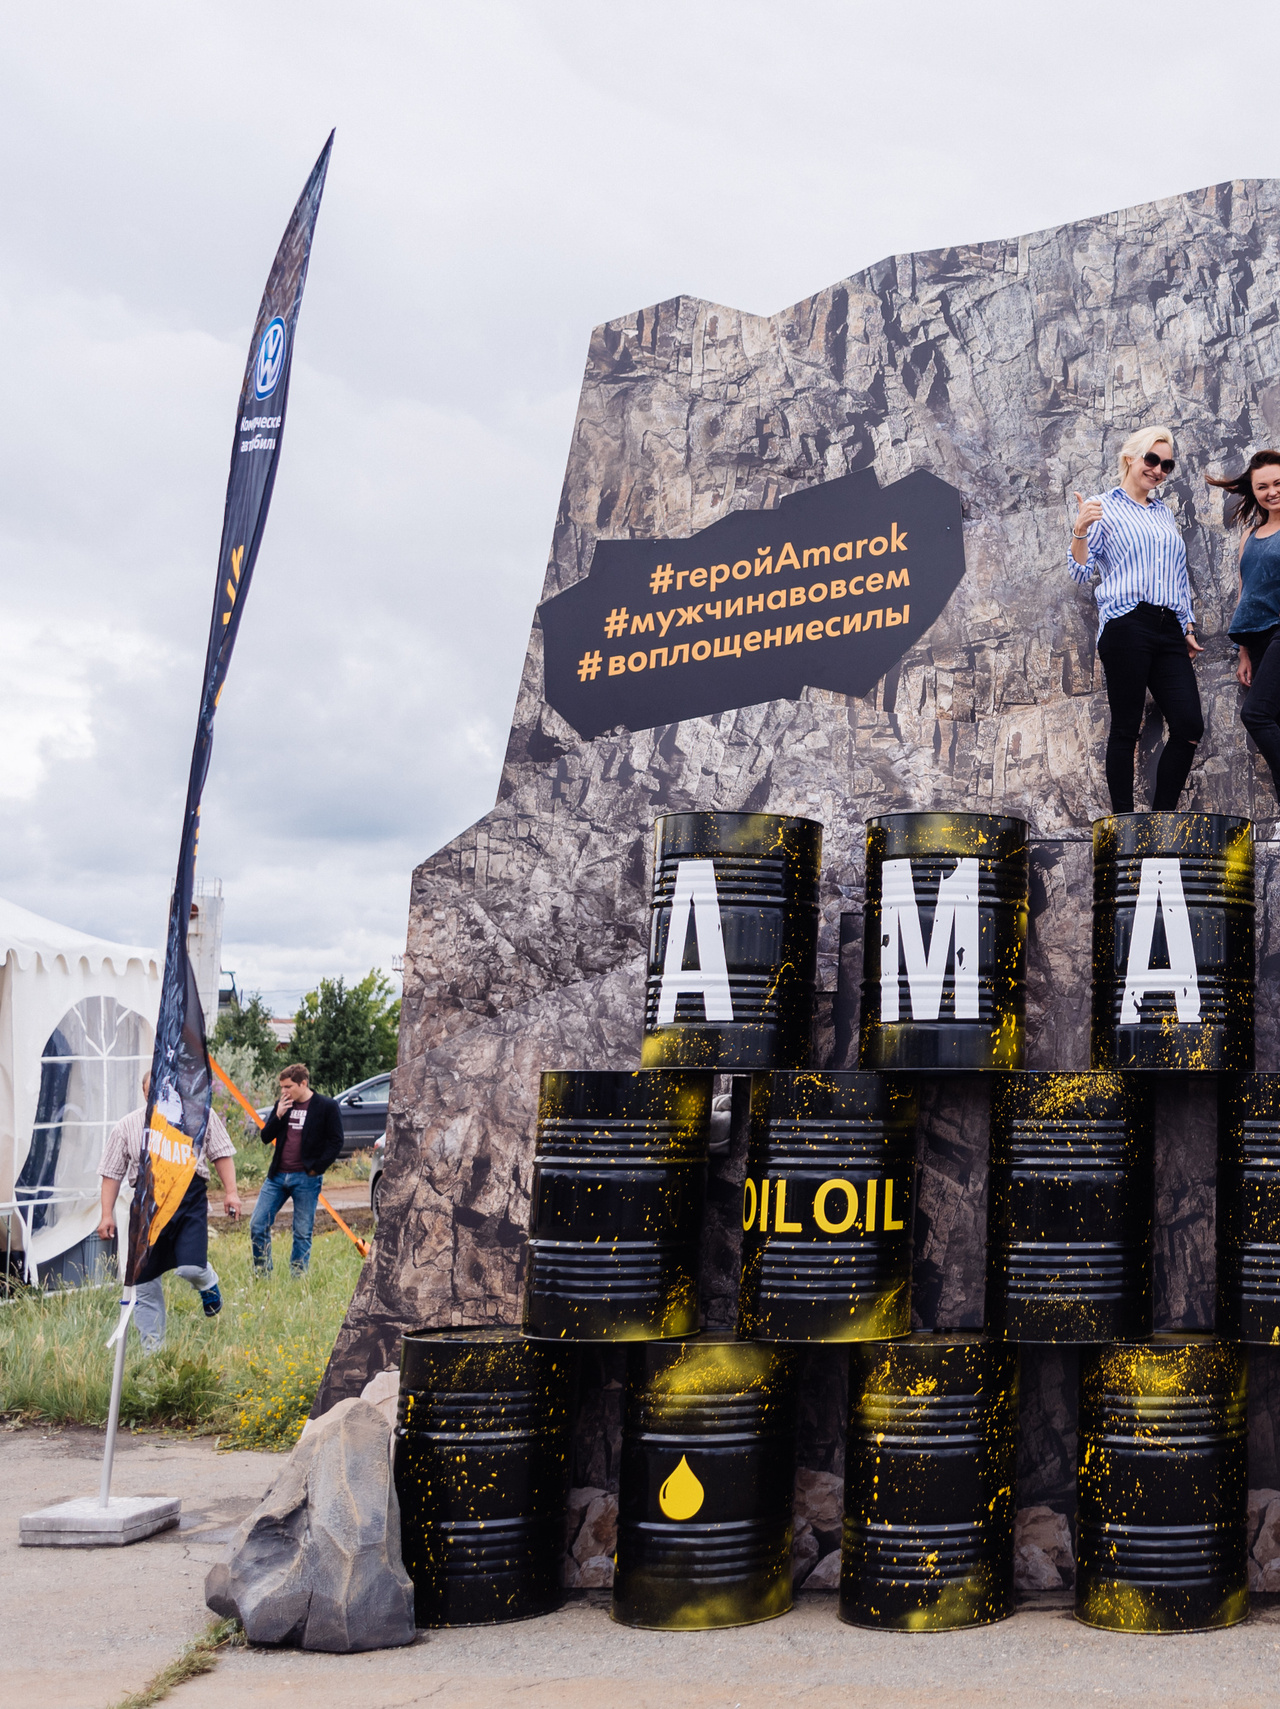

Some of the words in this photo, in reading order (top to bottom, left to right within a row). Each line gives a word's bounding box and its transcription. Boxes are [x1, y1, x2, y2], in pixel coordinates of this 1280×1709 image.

[650, 523, 909, 595] #геройAmarok
[604, 568, 911, 639] #мужчинавовсем
[742, 1177, 803, 1233] OIL
[813, 1178, 904, 1234] OIL
